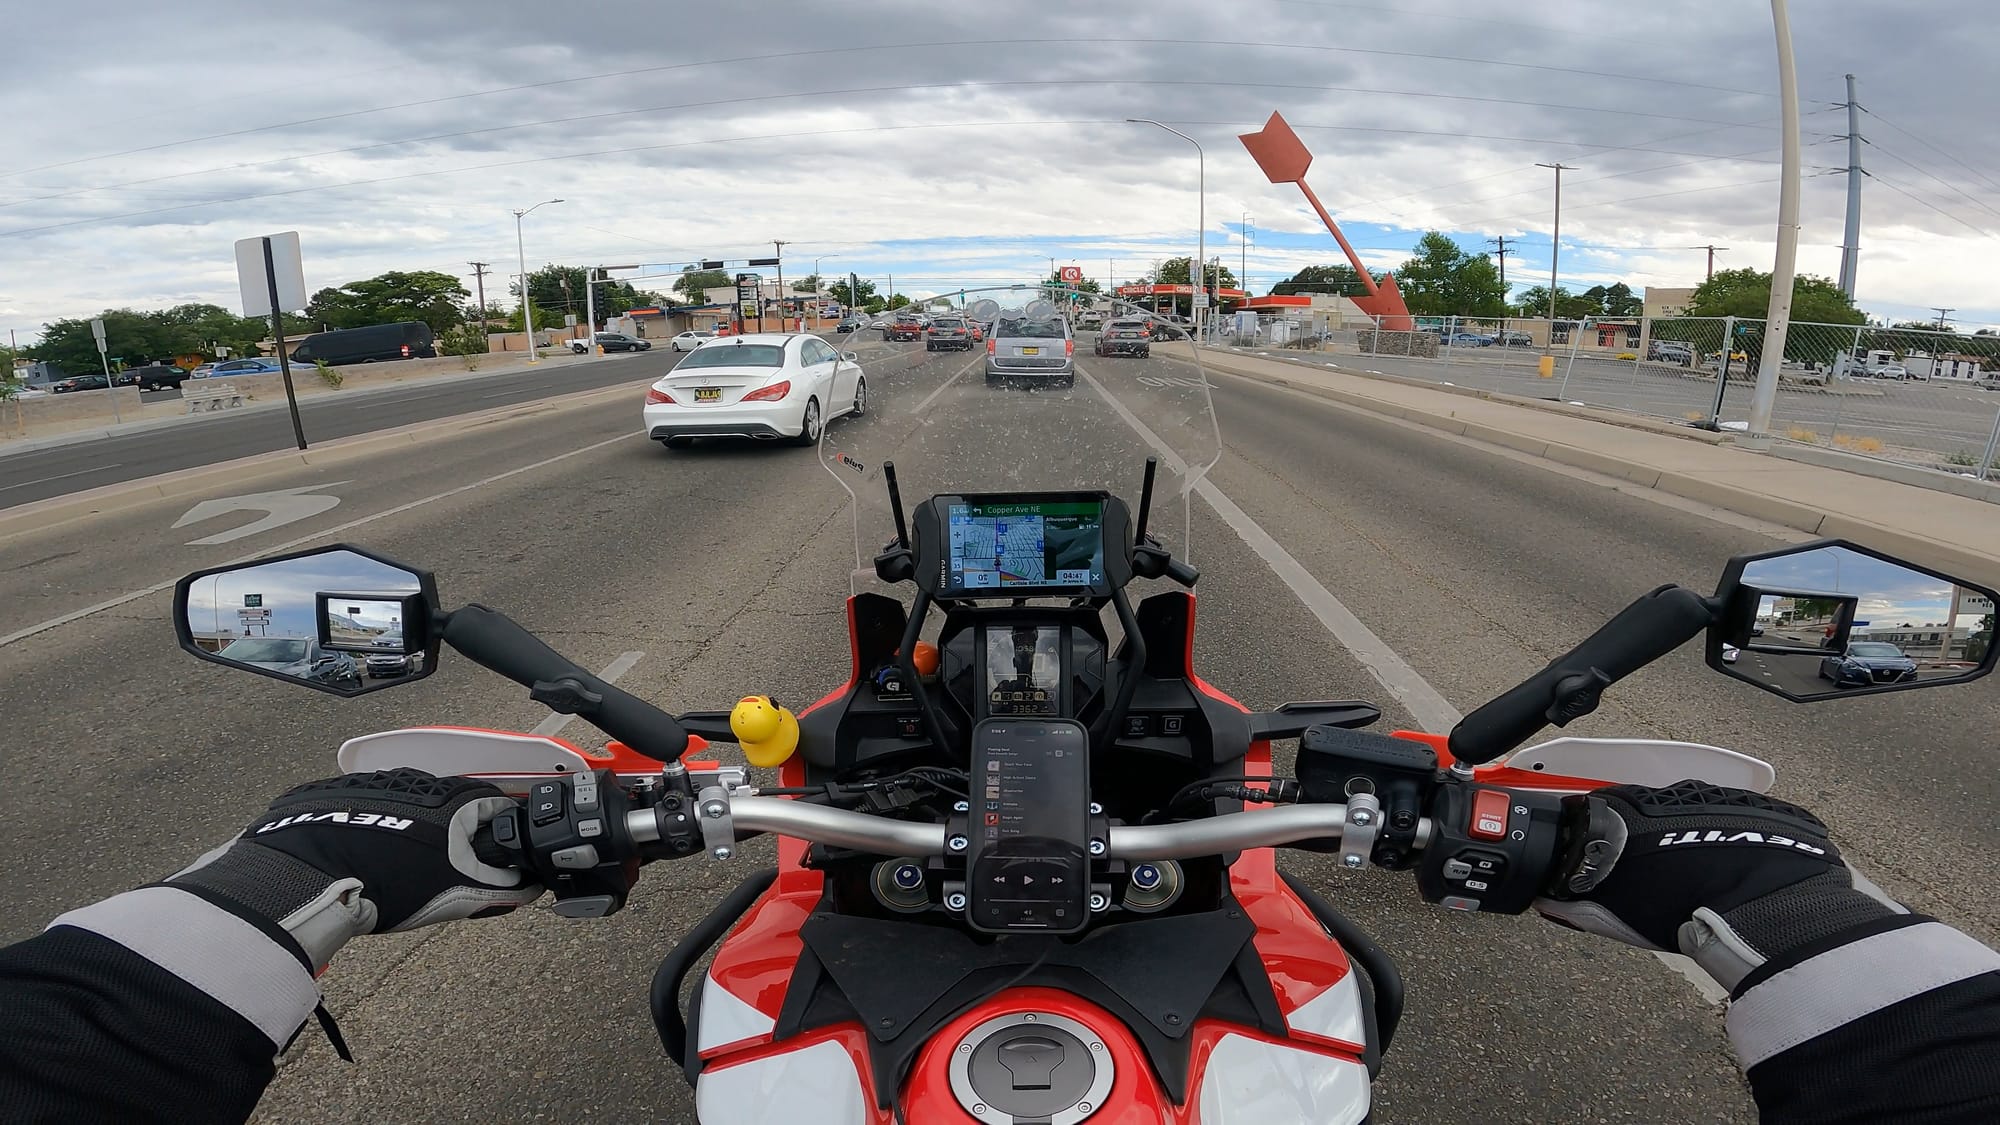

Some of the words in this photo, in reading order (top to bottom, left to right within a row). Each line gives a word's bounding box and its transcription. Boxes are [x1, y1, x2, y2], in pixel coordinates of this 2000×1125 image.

[987, 506, 1013, 516] Copper
[1014, 506, 1029, 514] Ave
[1031, 505, 1041, 513] NE
